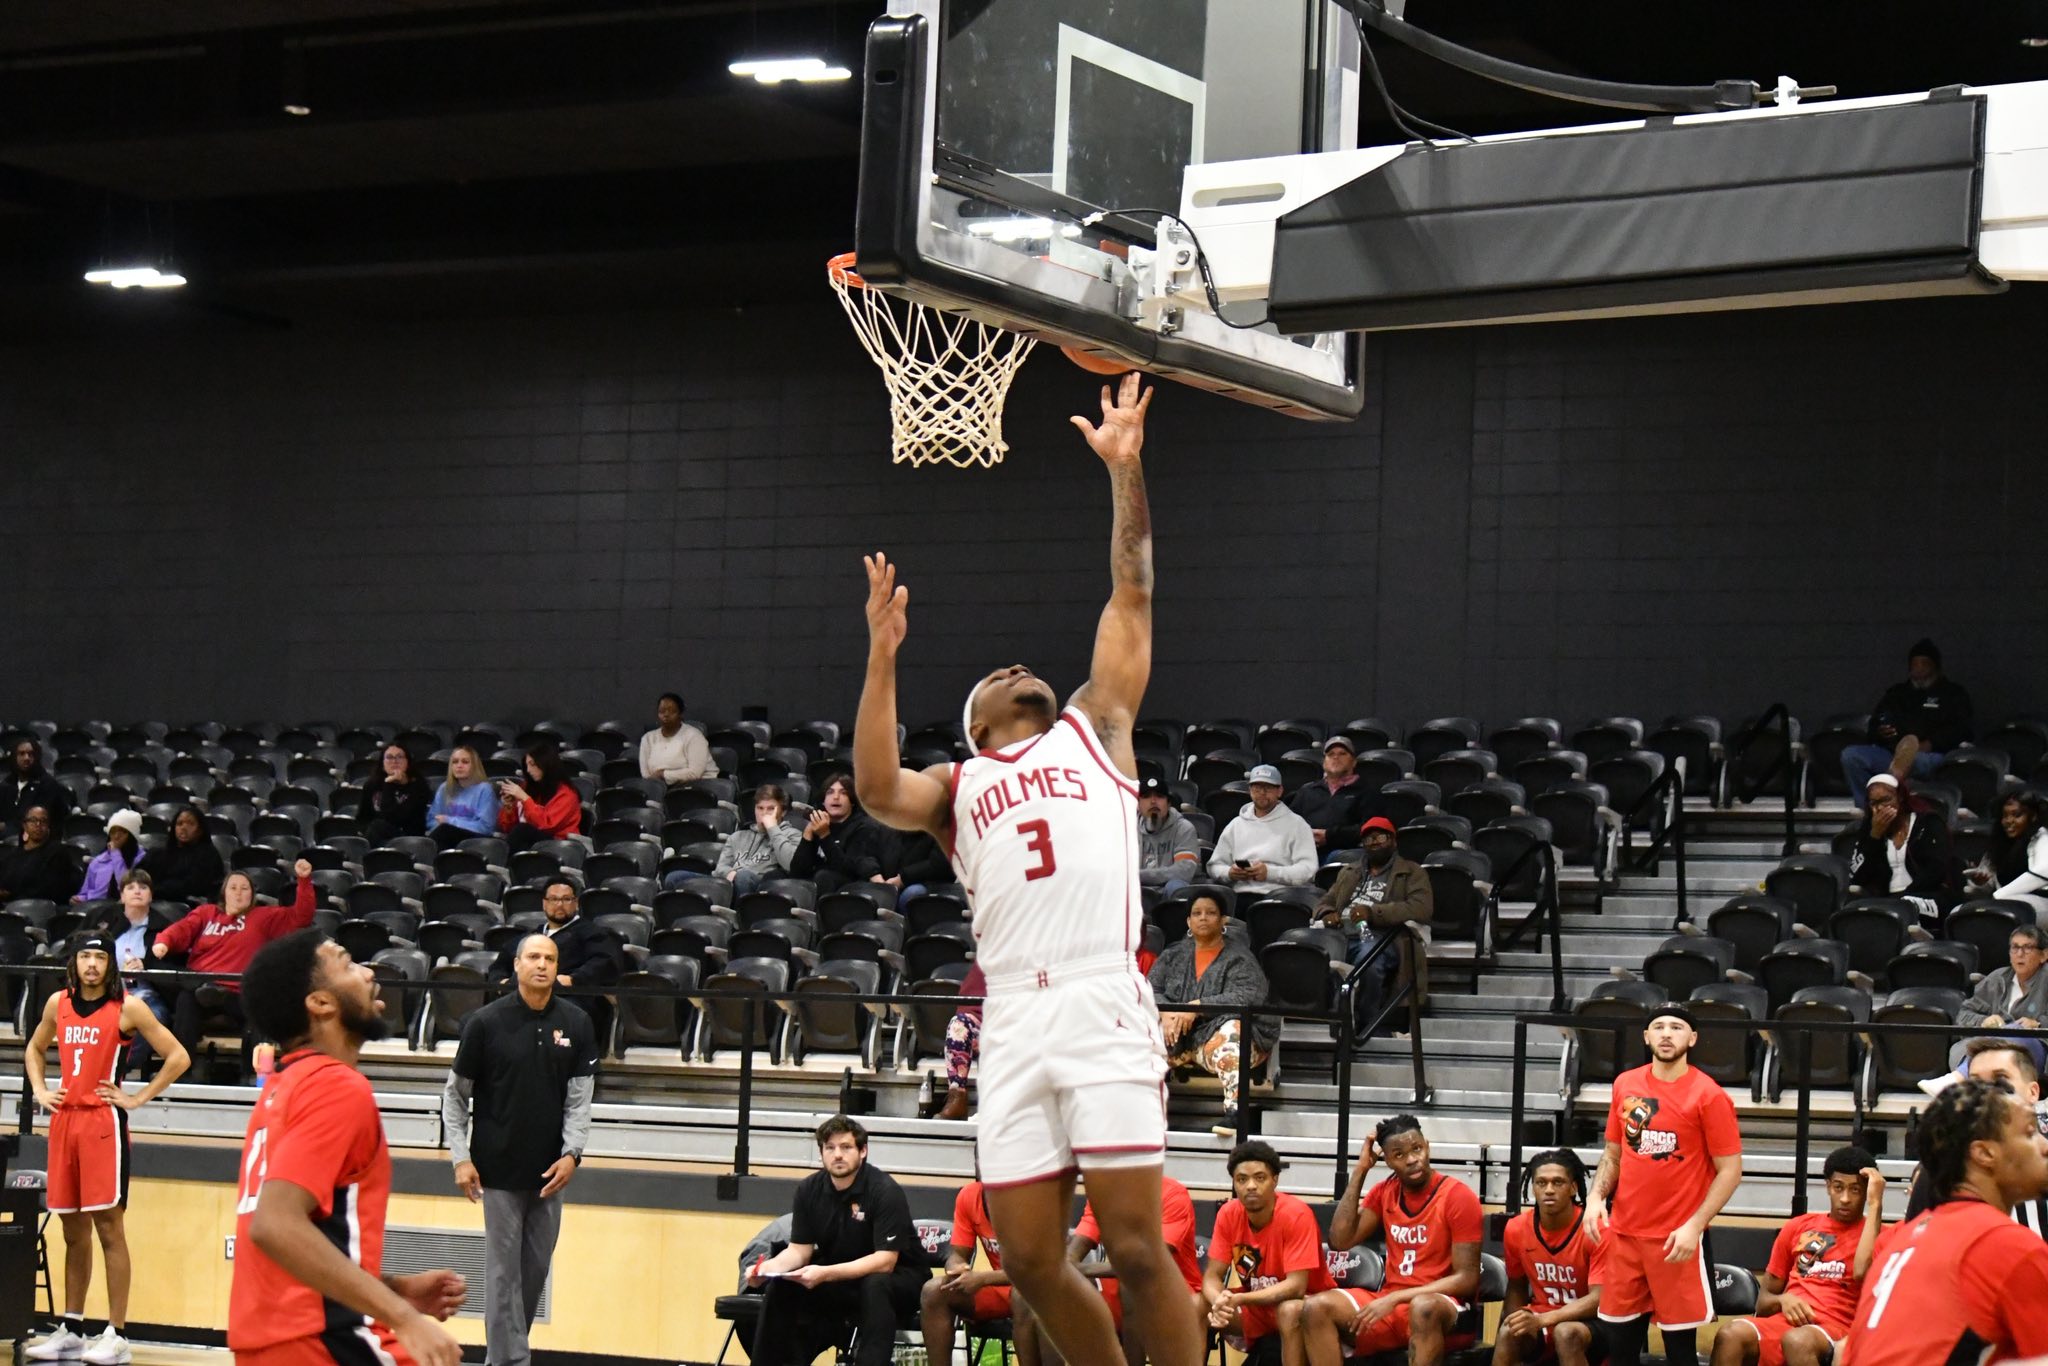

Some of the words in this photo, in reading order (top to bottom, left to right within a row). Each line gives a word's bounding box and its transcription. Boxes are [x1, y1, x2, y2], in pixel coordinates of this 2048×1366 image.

[970, 766, 1088, 841] HOLMES
[1016, 818, 1057, 882] 3
[1037, 970, 1048, 988] H
[64, 1025, 100, 1046] BRCC
[72, 1048, 84, 1077] 5
[1390, 1223, 1428, 1245] BRCC
[1398, 1249, 1417, 1277] 8
[1534, 1262, 1578, 1284] BRCC
[1866, 1246, 1917, 1330] 4
